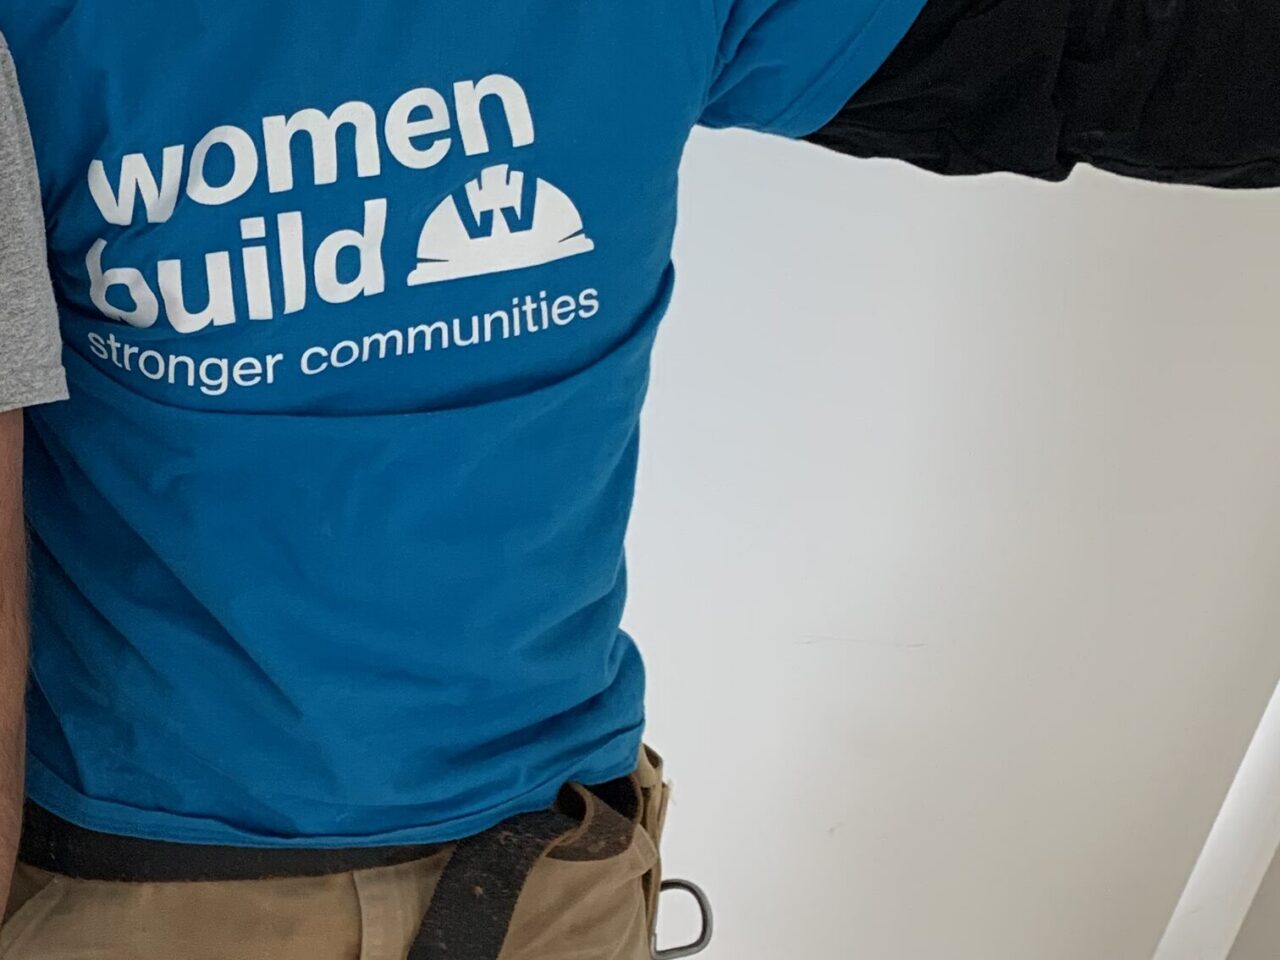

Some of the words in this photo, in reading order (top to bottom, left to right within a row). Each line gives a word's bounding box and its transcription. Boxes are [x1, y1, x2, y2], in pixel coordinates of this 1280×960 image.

[88, 73, 535, 226] women
[86, 198, 388, 333] build
[87, 330, 284, 396] stronger
[300, 287, 600, 376] communities
